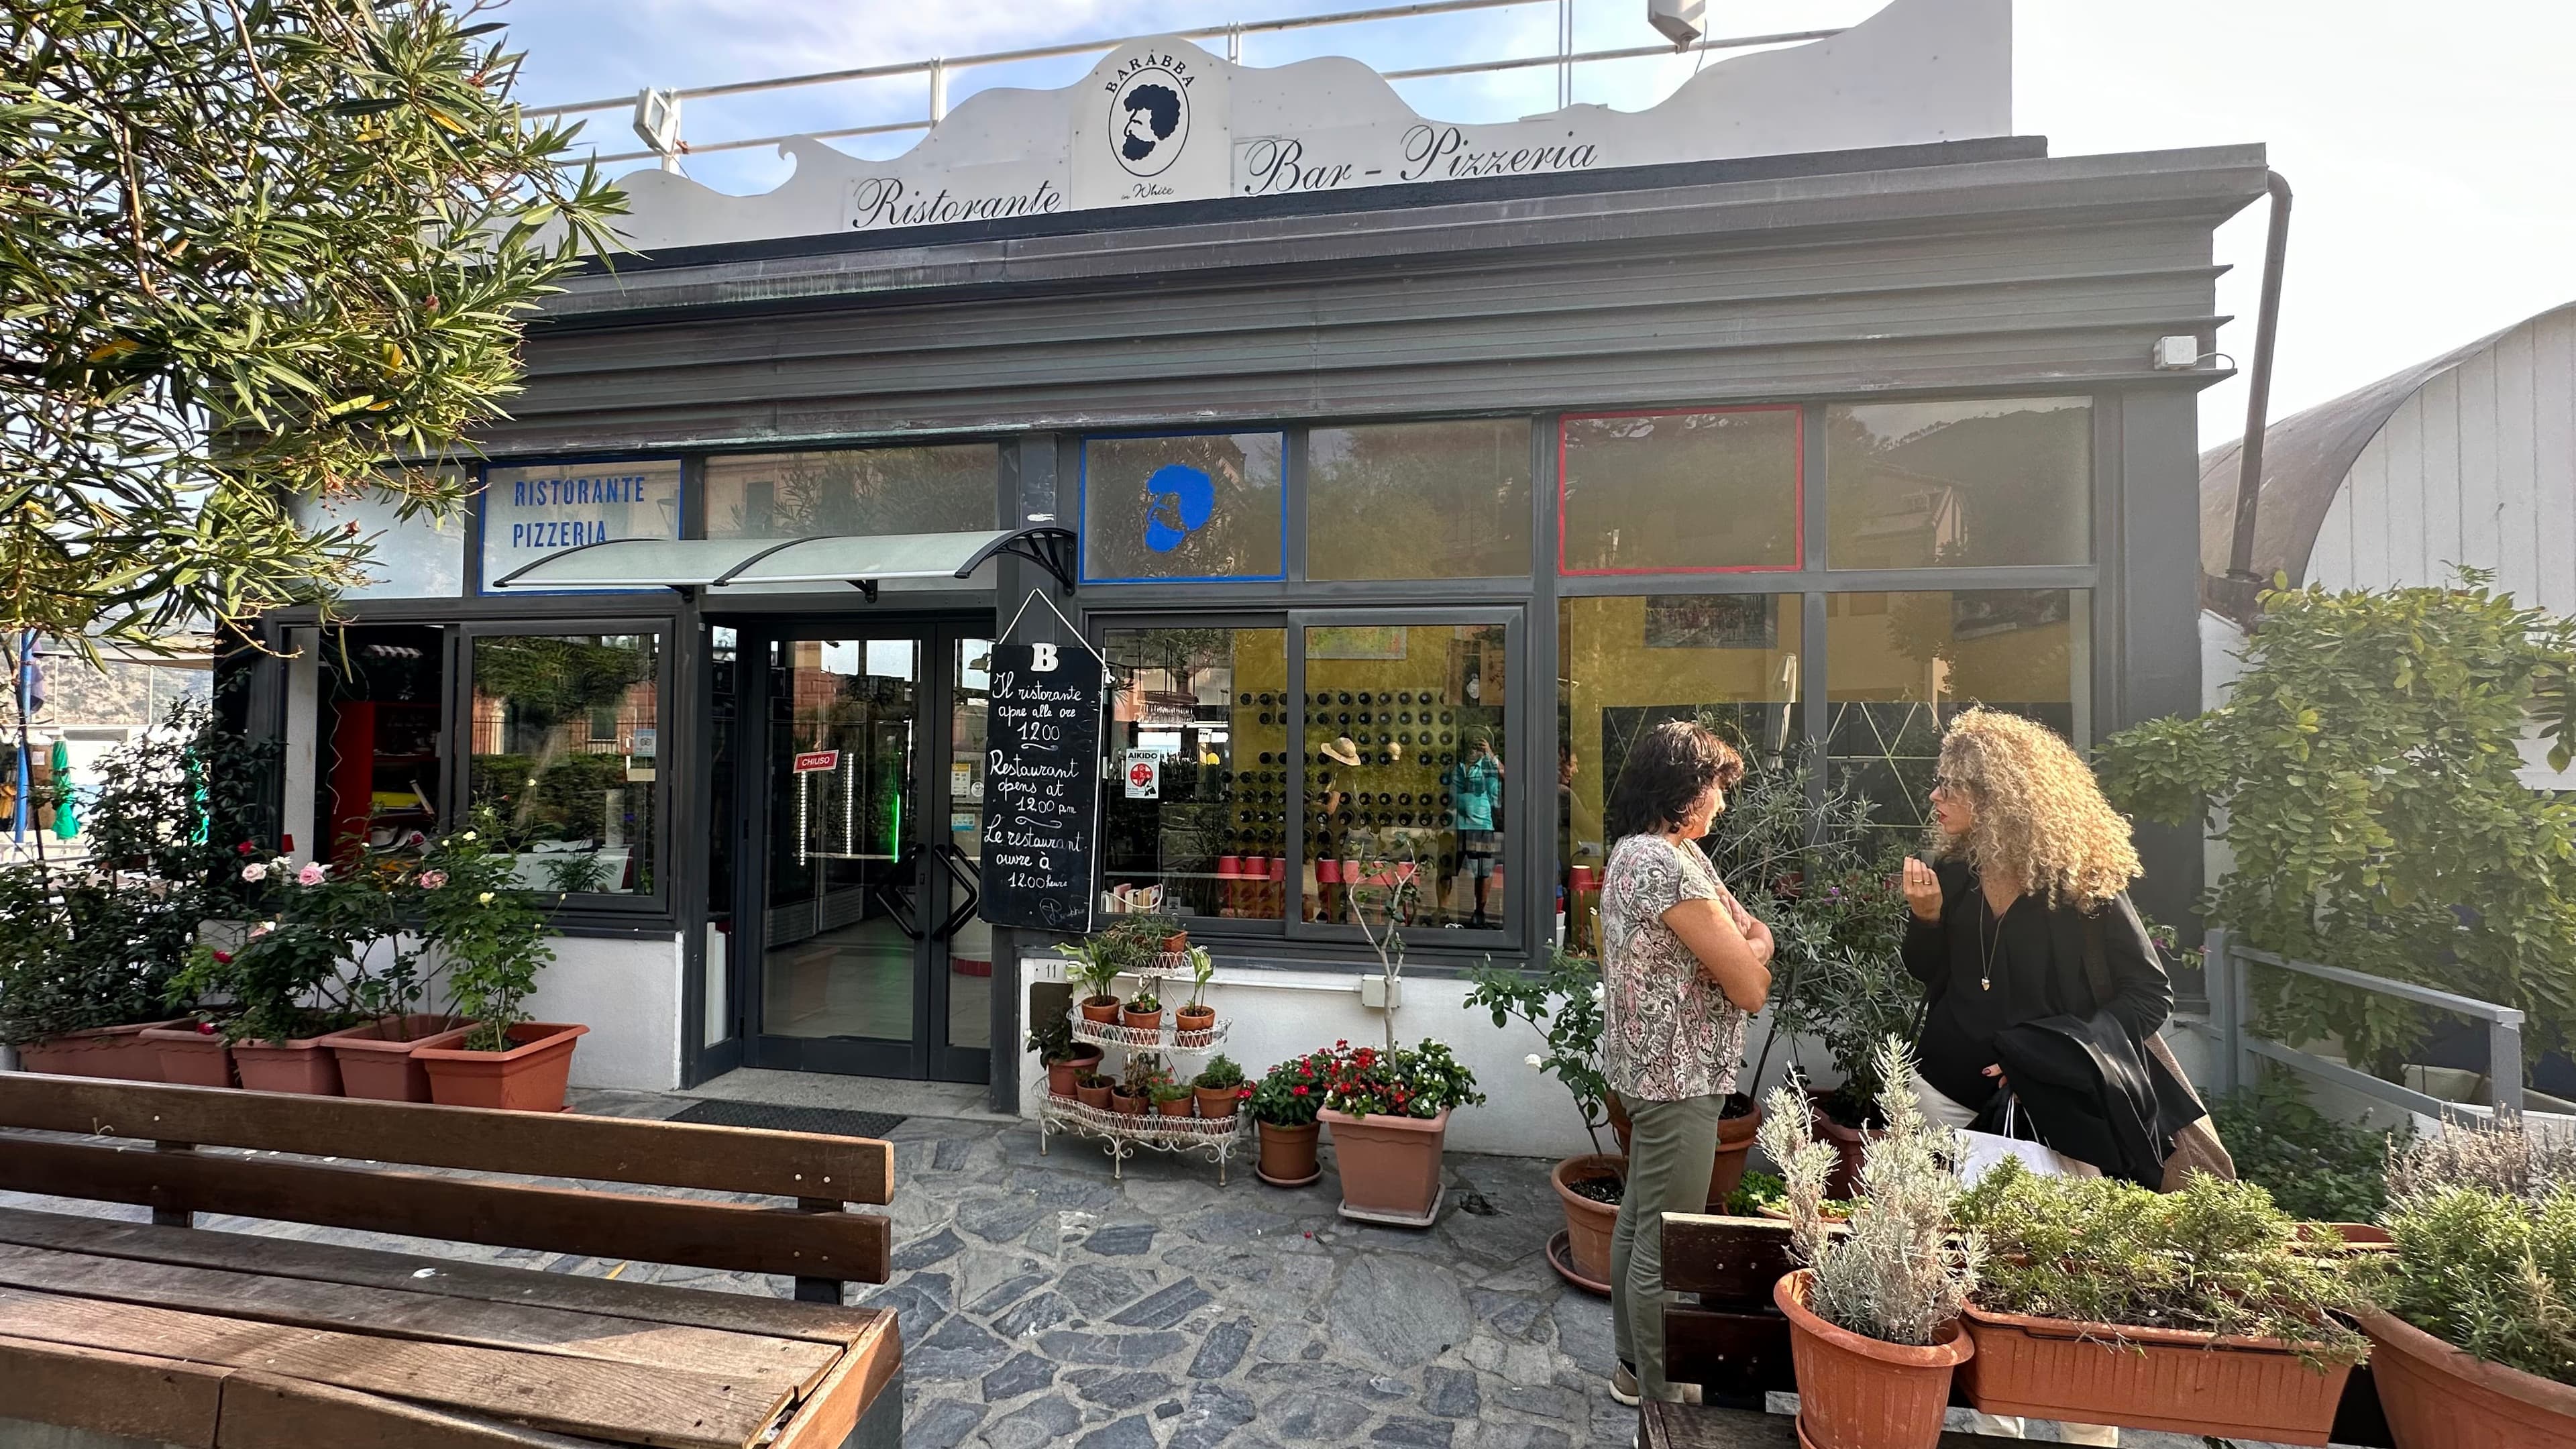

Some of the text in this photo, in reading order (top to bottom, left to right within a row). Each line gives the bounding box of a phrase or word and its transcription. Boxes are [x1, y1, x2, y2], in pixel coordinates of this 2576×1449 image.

[1105, 54, 1195, 94] BARABBA
[1244, 138, 1352, 195] Bar
[1400, 124, 1597, 181] Pizzeria
[853, 177, 1062, 228] Ristorante
[1132, 183, 1174, 198] White
[515, 476, 645, 506] RISTORANTE
[513, 521, 606, 547] PIZZERIA
[1030, 643, 1059, 672] B
[992, 671, 1082, 701] Il ristorante
[998, 704, 1076, 727] apre alle ore
[802, 756, 830, 766] CHIUSO
[989, 749, 1079, 778] Restaurant
[998, 777, 1064, 802] opens at
[984, 814, 1003, 843] Le
[996, 851, 1052, 871] ouvre à
[1046, 963, 1057, 977] 11
